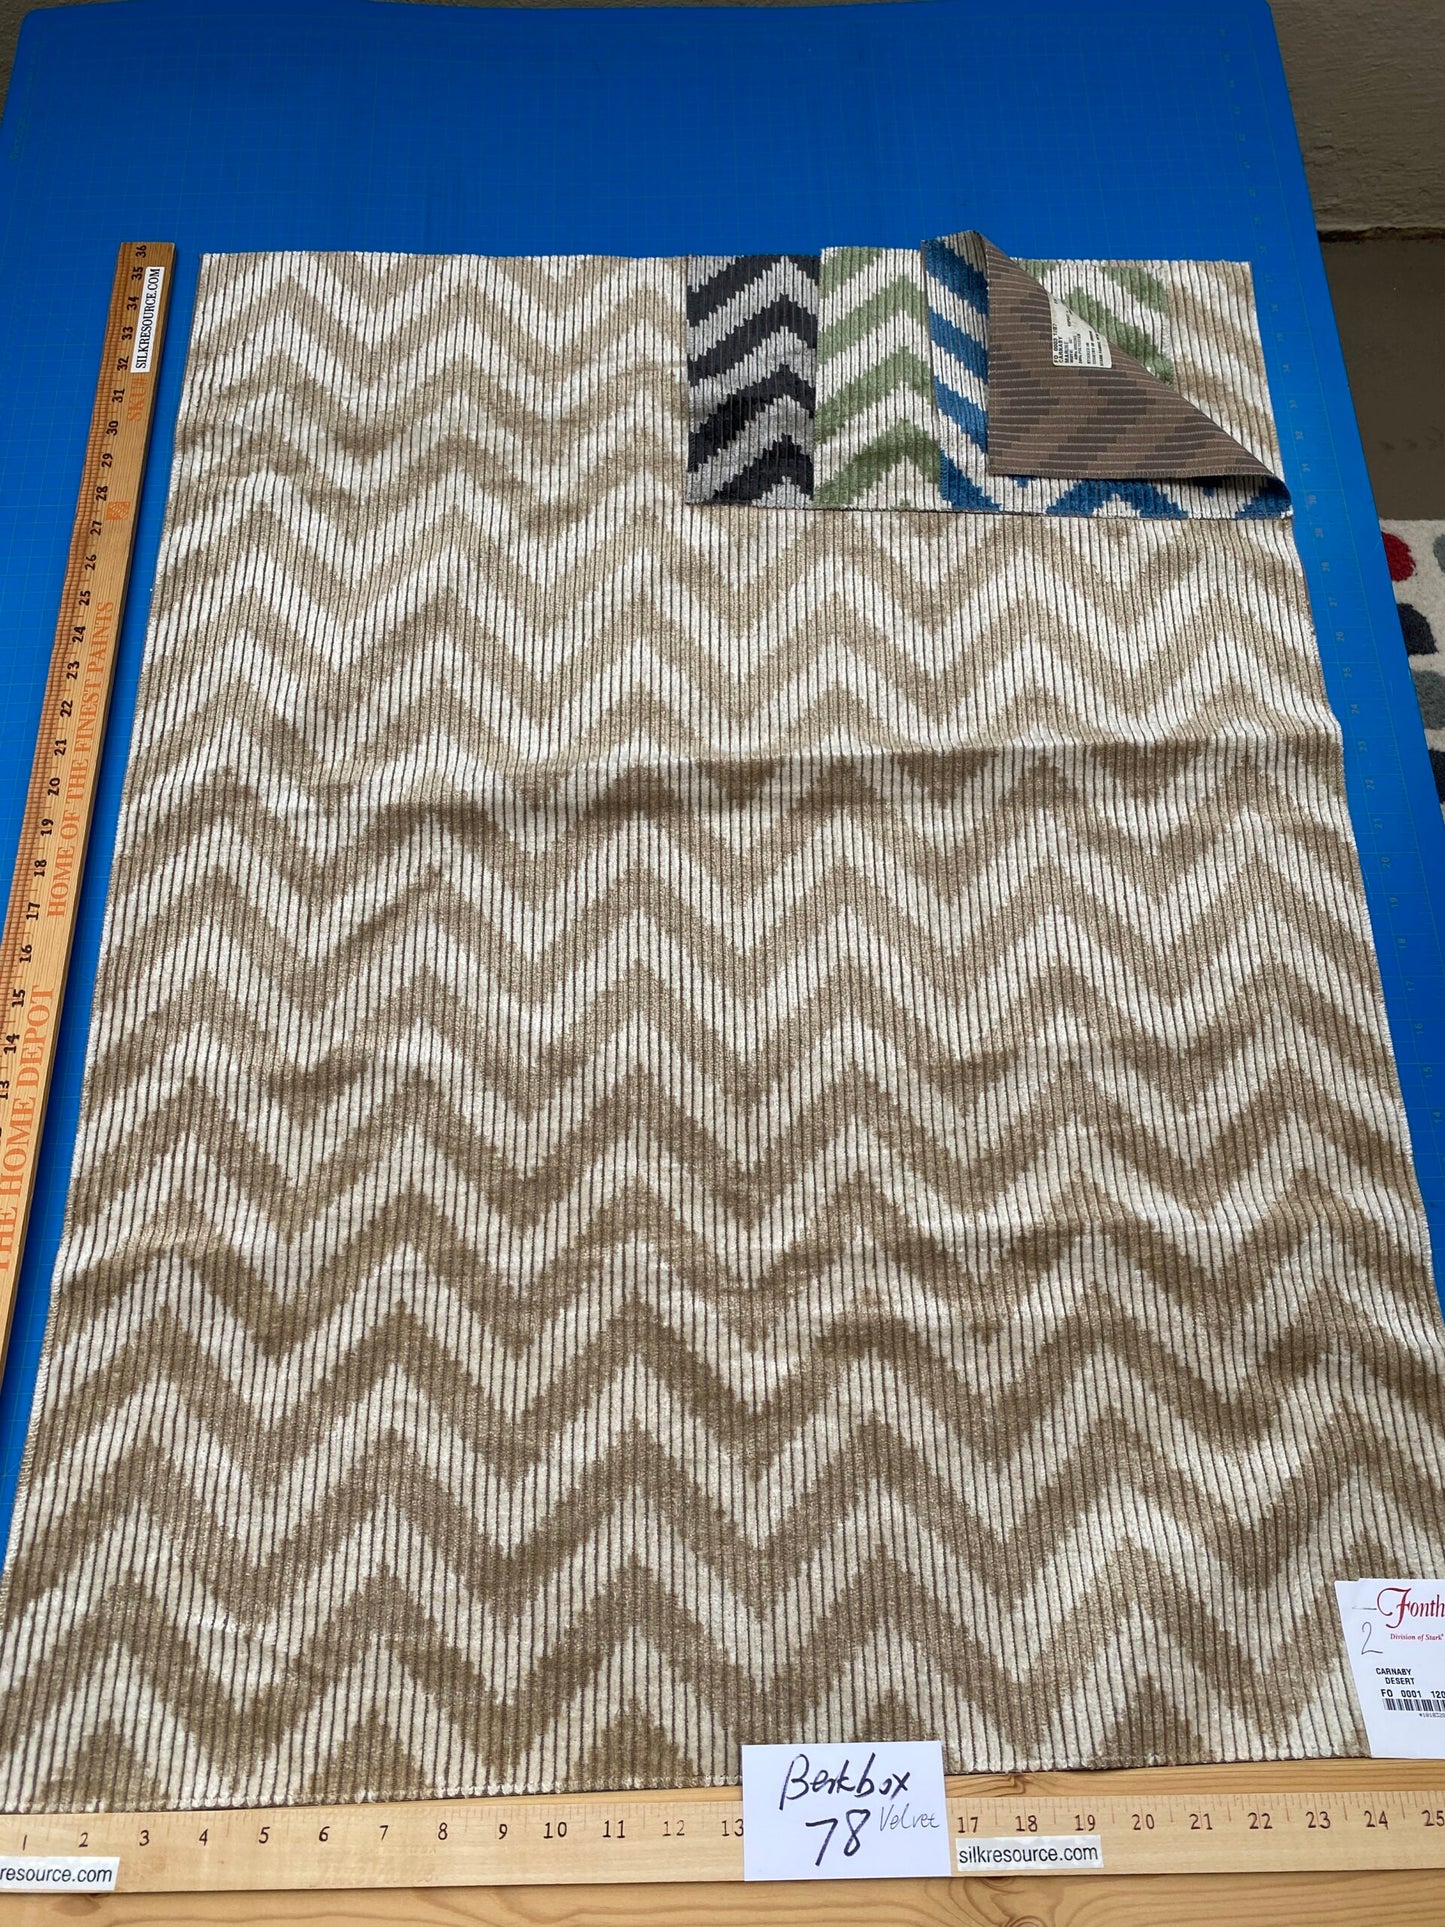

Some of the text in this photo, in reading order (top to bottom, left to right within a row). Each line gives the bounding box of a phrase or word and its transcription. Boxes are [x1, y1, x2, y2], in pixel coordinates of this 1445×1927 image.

[136, 245, 147, 258] 36
[131, 266, 143, 281] 35
[127, 296, 139, 311] 34
[136, 268, 160, 369] SILKRESOURCE.COM
[122, 326, 134, 341] 33
[117, 356, 129, 371] 32
[112, 388, 125, 403] 31
[106, 420, 119, 436] 30
[102, 453, 113, 468] 29
[96, 486, 108, 501] 28
[90, 521, 103, 536] 27
[85, 554, 97, 571] 26
[79, 590, 91, 606] 25
[72, 626, 86, 643] 24
[66, 661, 80, 680] 23
[60, 700, 73, 718] 22
[54, 738, 67, 756] 21
[47, 601, 114, 918] HOME OF THE FINEST PAINTS
[48, 777, 61, 796] 20
[41, 818, 54, 836] 19
[34, 859, 47, 877] 18
[26, 902, 40, 920] 17
[20, 944, 33, 963] 16
[12, 989, 25, 1008] 15
[4, 1033, 20, 1055] 14
[16, 984, 55, 1088] DEPOT
[0, 1096, 36, 1198] HOME
[1377, 1587, 1445, 1628] Fonth
[1361, 1621, 1383, 1655] 2
[1390, 1633, 1416, 1641] Division
[1417, 1633, 1425, 1642] of
[1376, 1667, 1411, 1676] CARNABY
[1385, 1677, 1415, 1685] DESERT
[1380, 1689, 1393, 1698] FO
[1400, 1689, 1422, 1698] 0001
[21, 1809, 1445, 1851] 1 2 3 4 5 6 7 8 9 10 11 12 13 17 18 19 20 21 22 23 24 25
[805, 1803, 942, 1867] 78 Velvet
[958, 1844, 1099, 1865] silkresource.com
